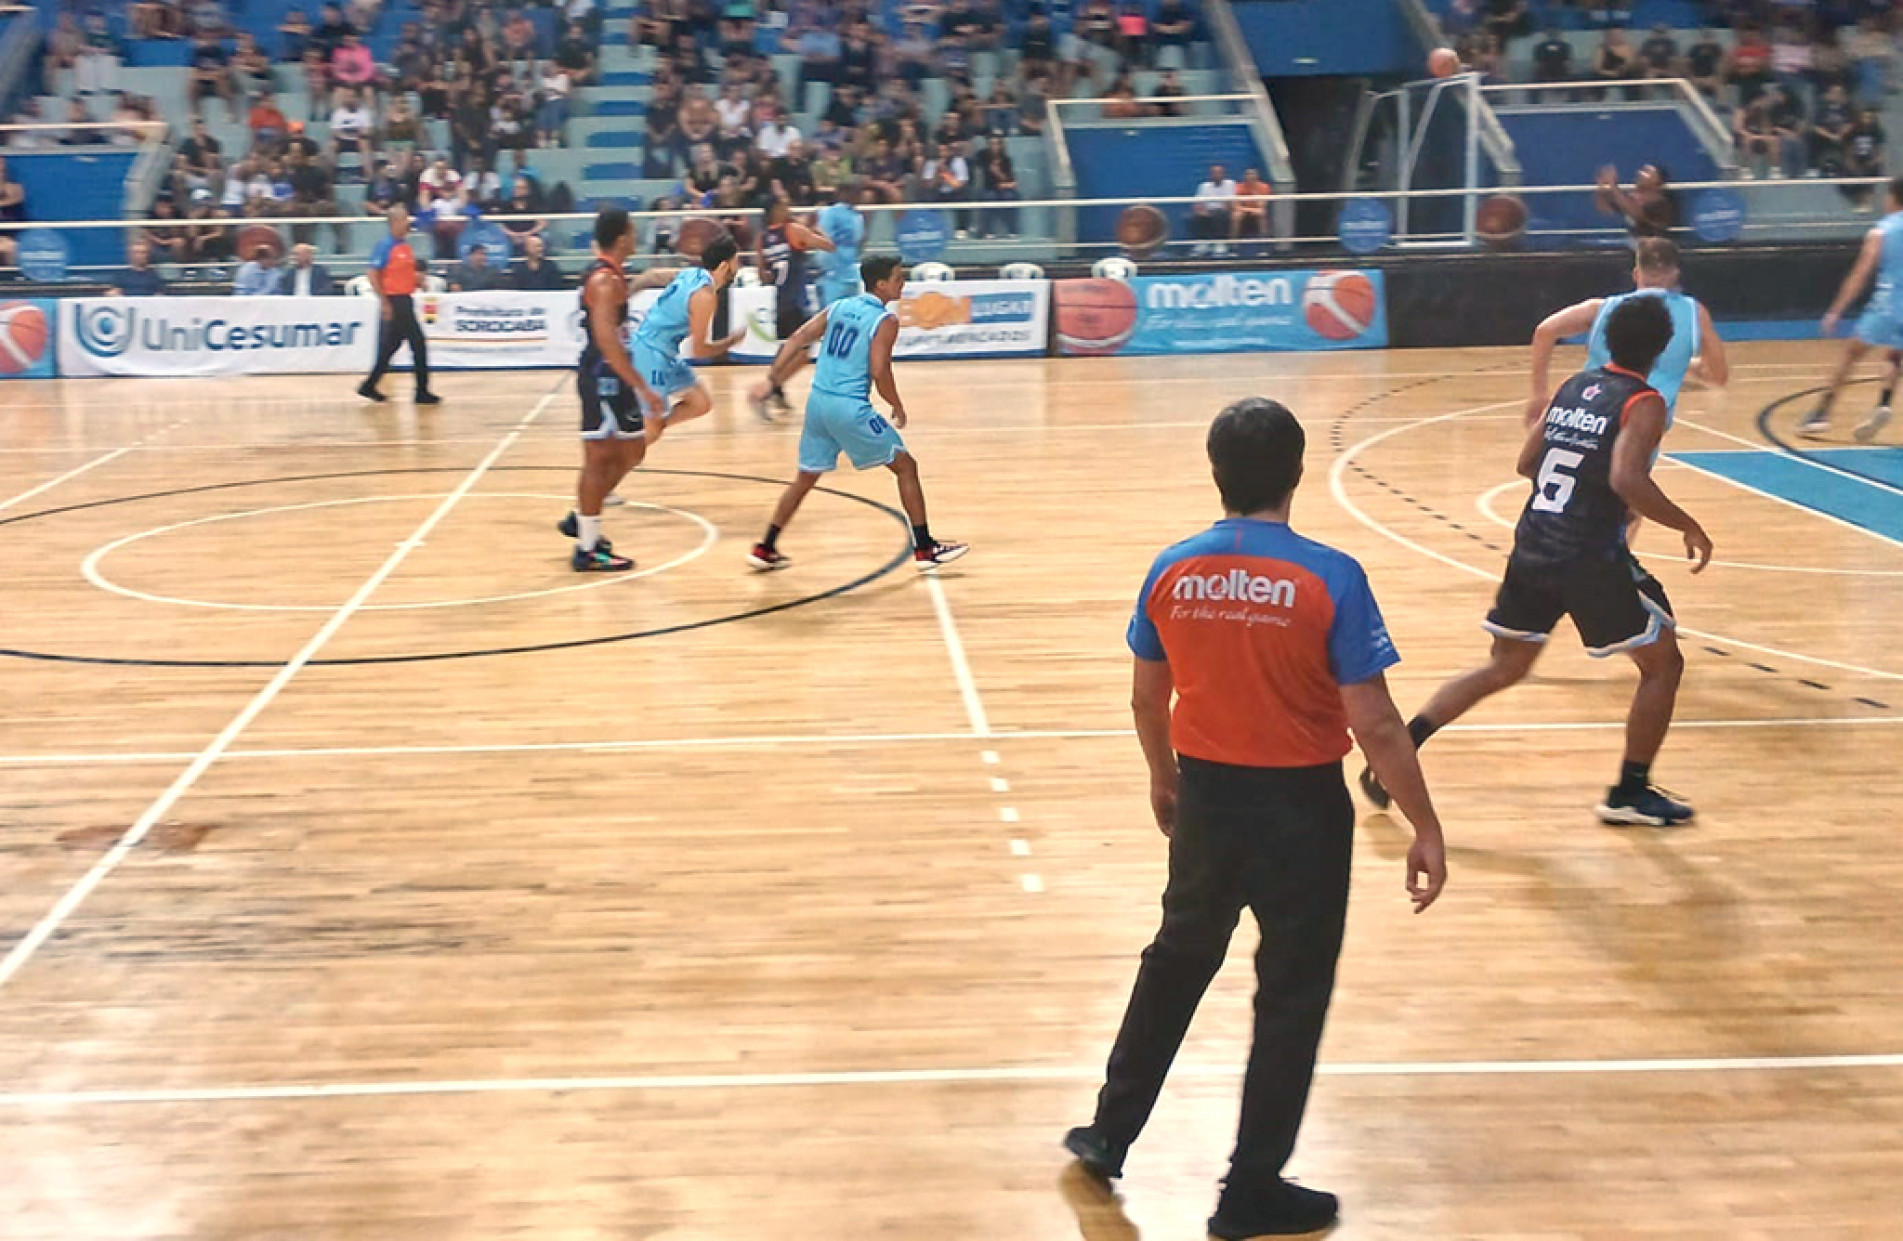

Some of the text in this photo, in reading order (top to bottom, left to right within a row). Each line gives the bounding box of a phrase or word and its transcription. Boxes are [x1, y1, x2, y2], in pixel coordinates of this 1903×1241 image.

[1147, 274, 1292, 309] molten
[142, 317, 362, 351] UniCesumar
[827, 321, 859, 358] 00
[1546, 406, 1608, 435] molten
[1531, 446, 1585, 513] 6
[1172, 567, 1296, 608] molten
